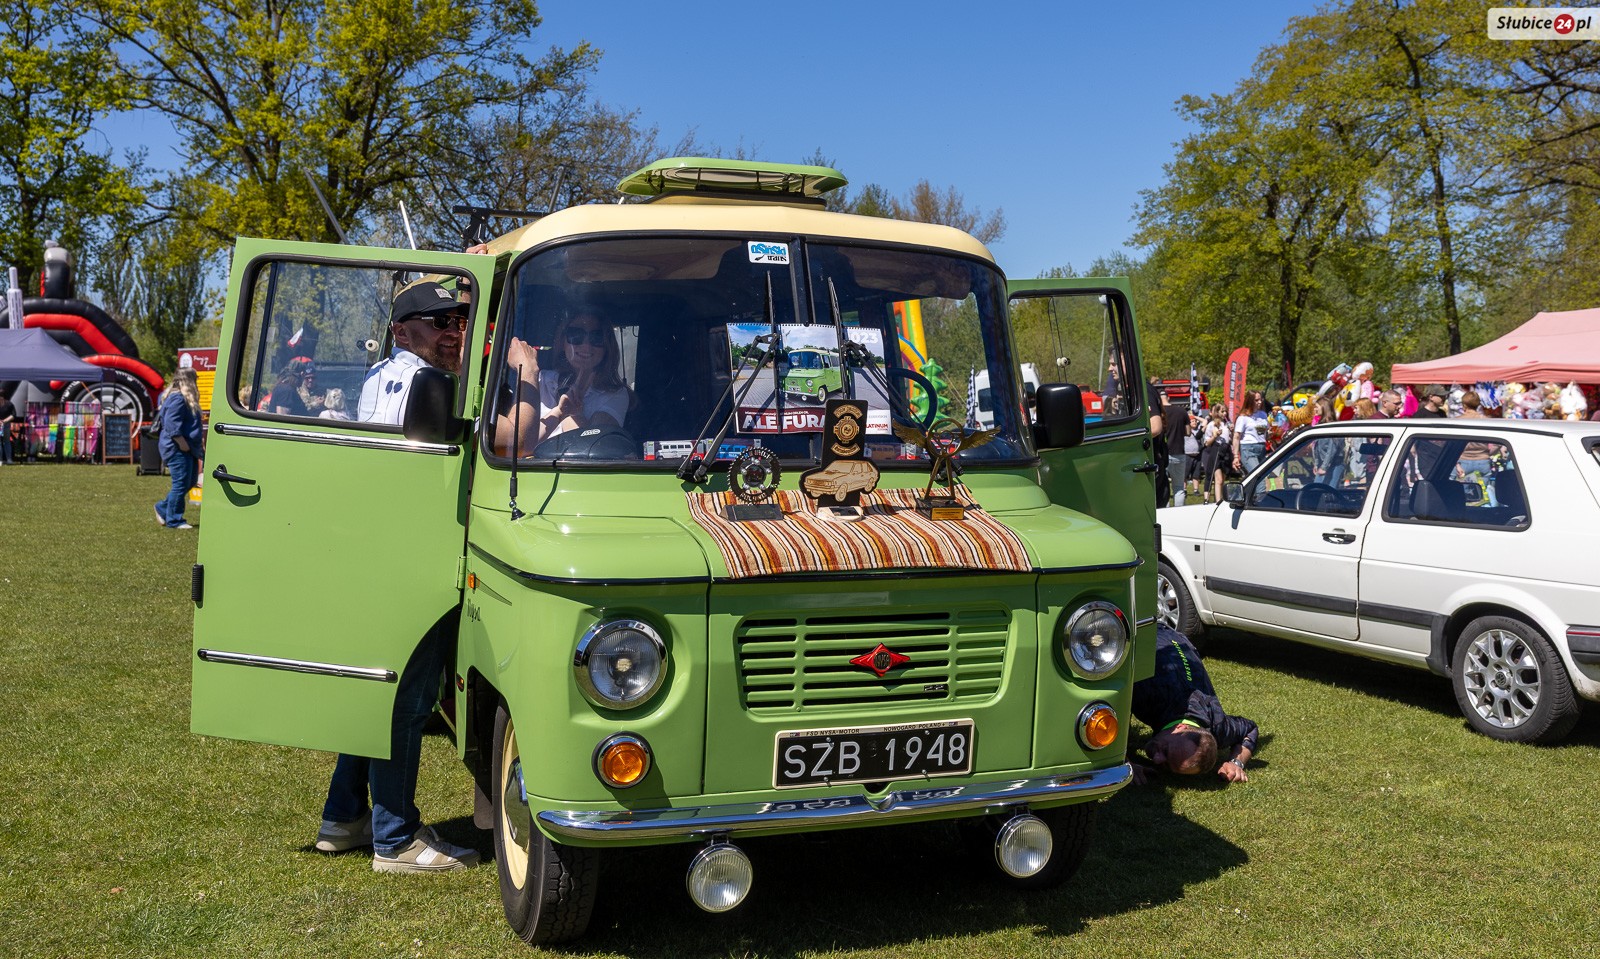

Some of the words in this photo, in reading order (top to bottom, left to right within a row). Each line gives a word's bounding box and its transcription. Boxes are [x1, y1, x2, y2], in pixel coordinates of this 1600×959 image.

[849, 331, 879, 345] 023
[742, 414, 778, 430] ALE
[784, 740, 861, 779] SZB
[885, 733, 966, 771] 1948
